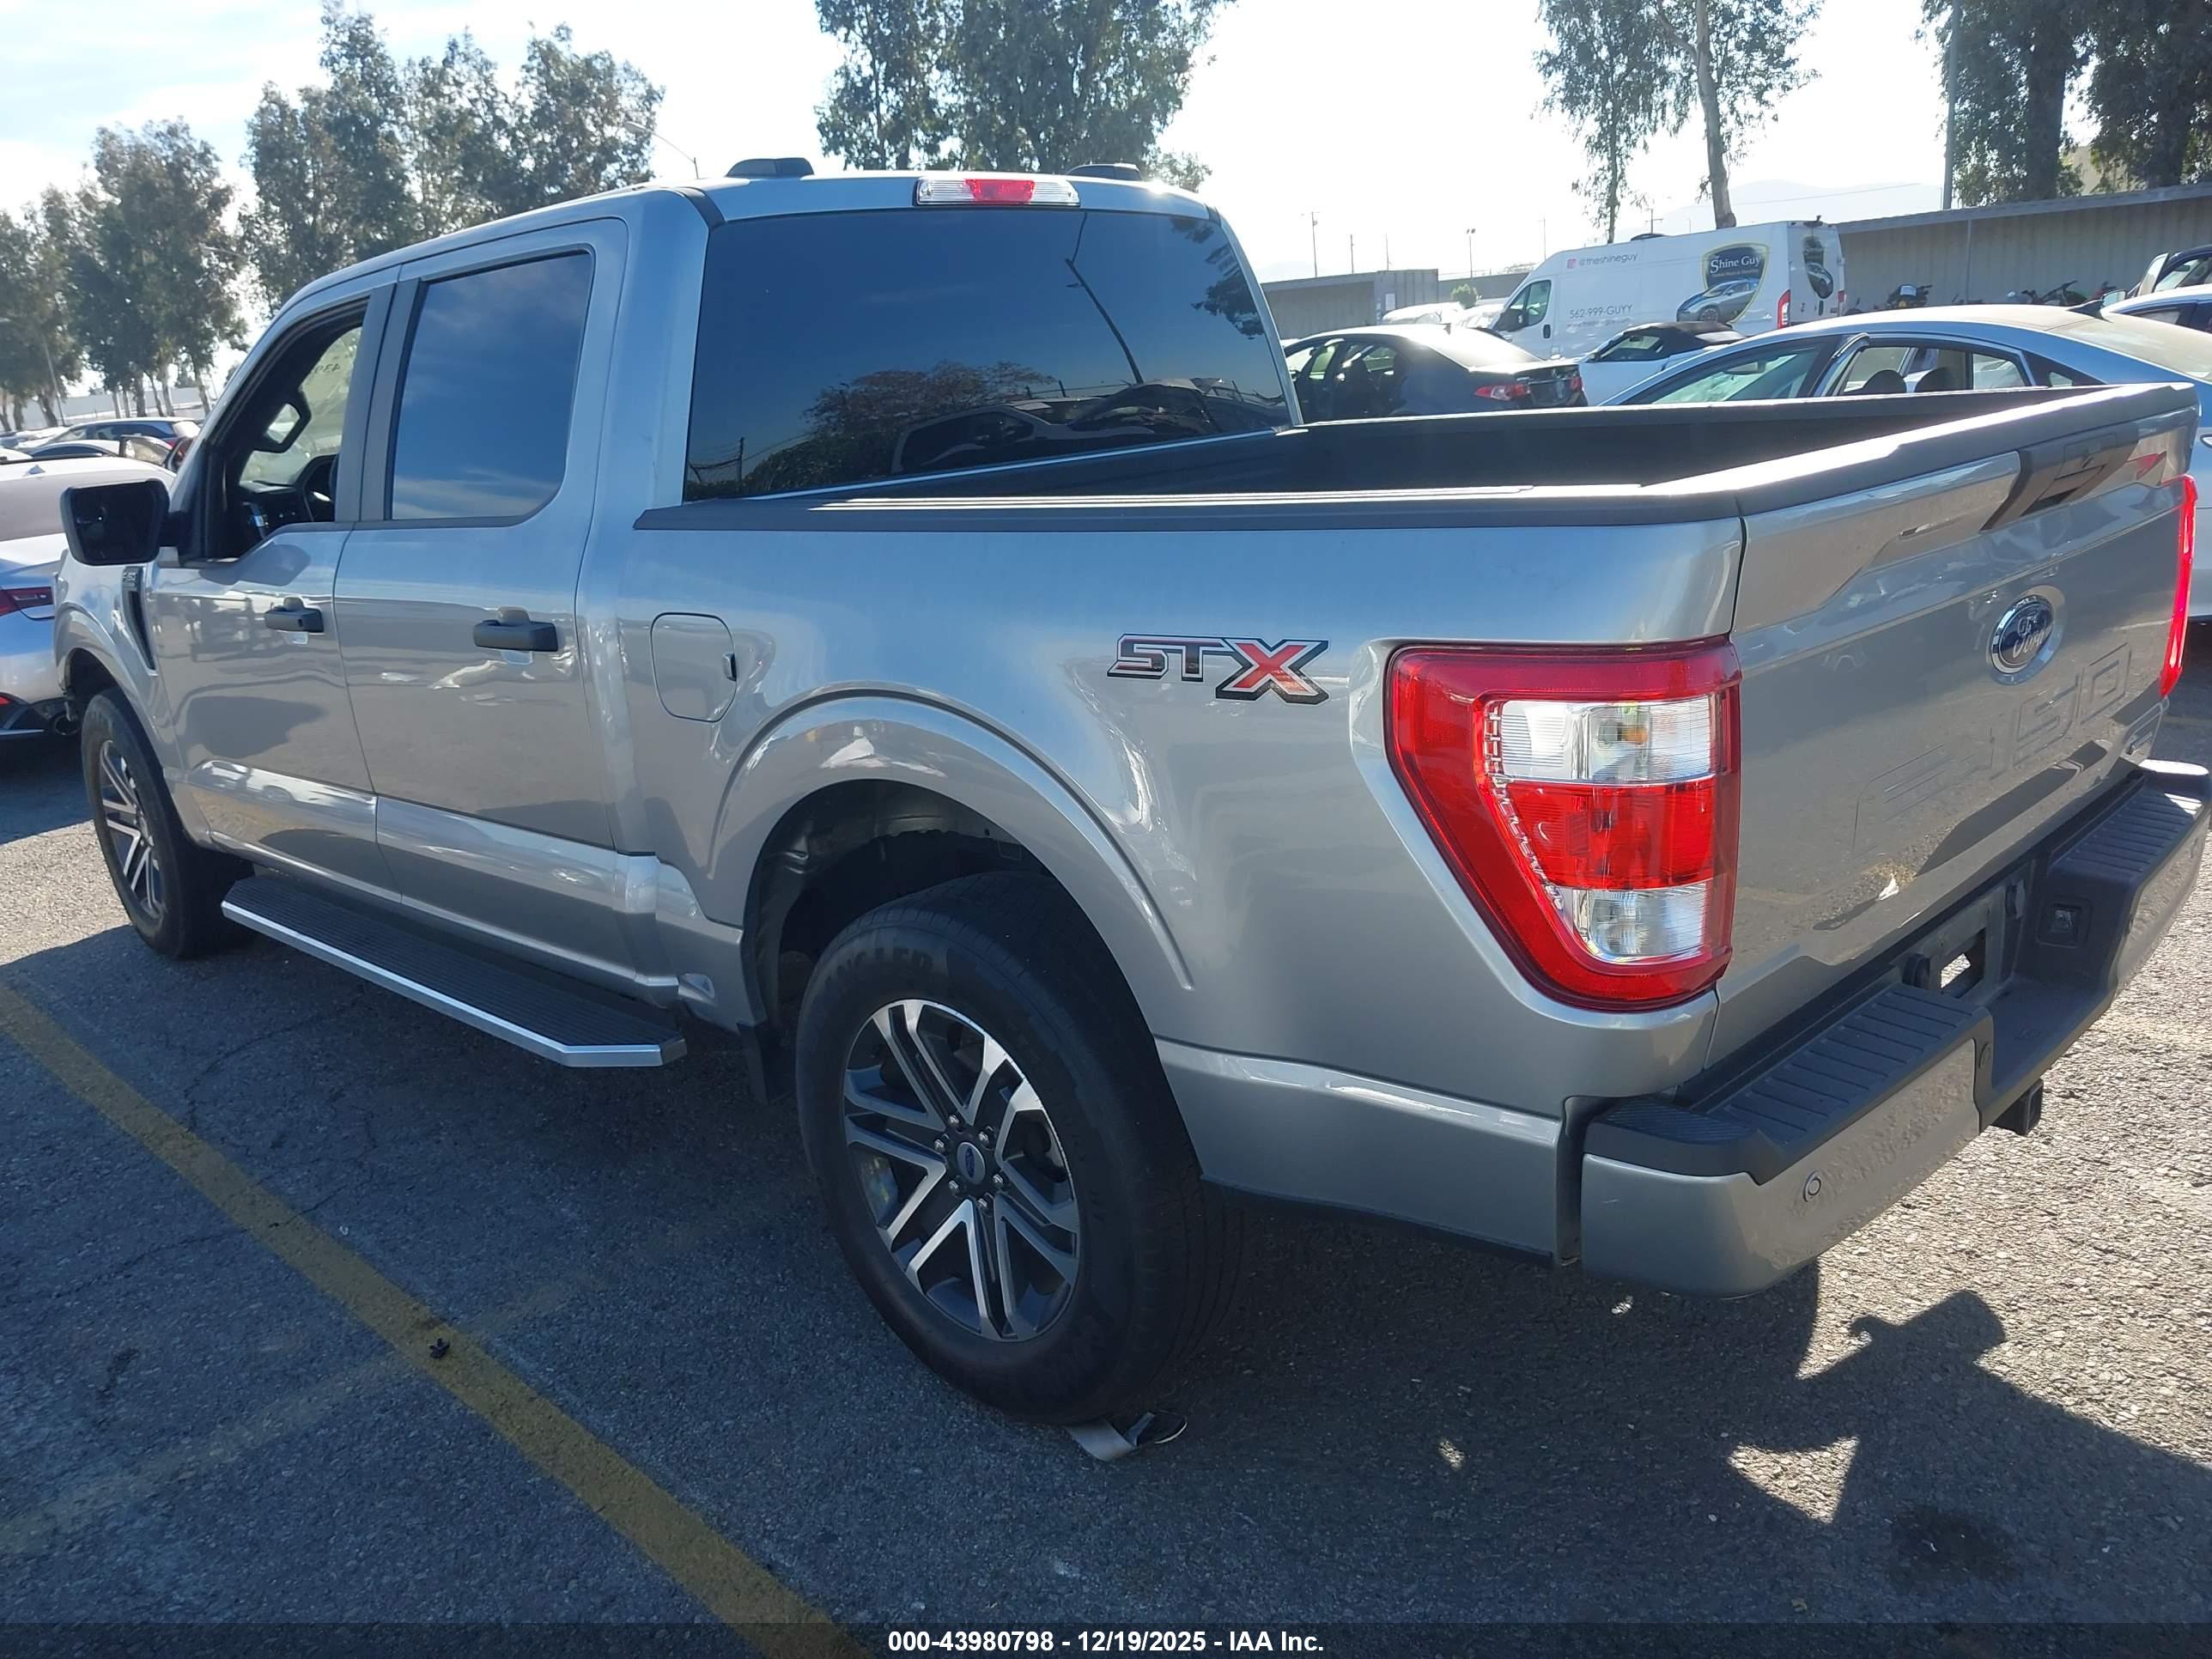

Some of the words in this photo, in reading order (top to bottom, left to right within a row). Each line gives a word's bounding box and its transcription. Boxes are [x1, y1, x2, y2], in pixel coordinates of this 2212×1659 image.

[1579, 253, 1638, 266] @theshineguy
[1711, 258, 1739, 274] Shine
[1741, 256, 1760, 267] Guy
[1569, 304, 1632, 319] 562-999-GUYY
[1106, 633, 1329, 705] STX
